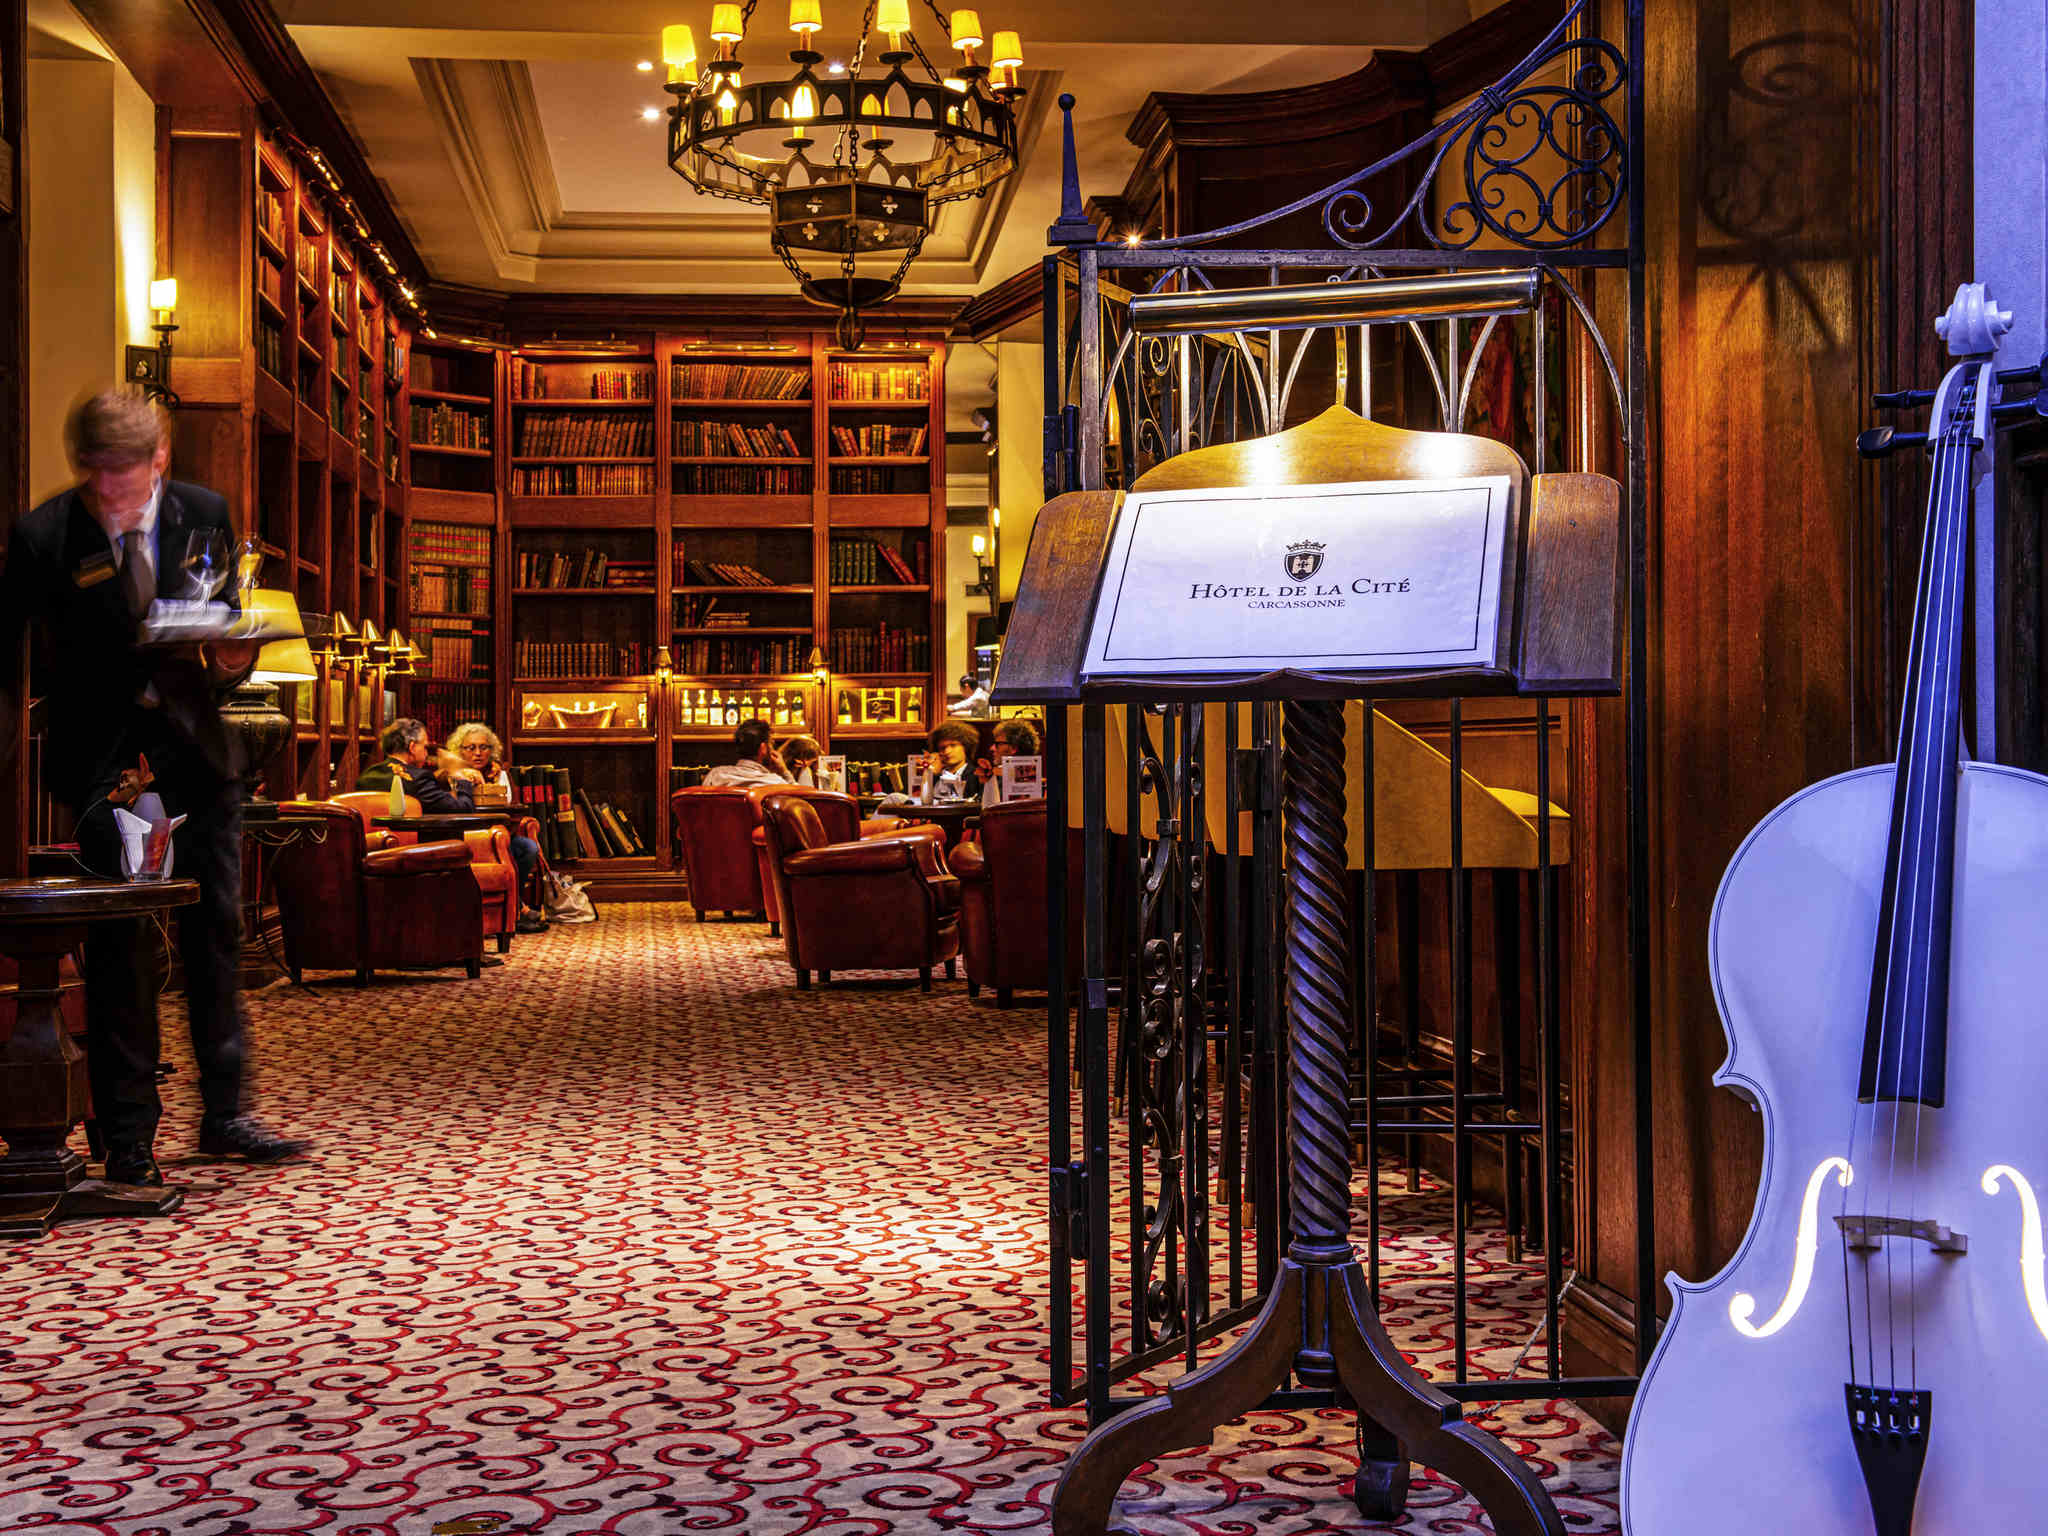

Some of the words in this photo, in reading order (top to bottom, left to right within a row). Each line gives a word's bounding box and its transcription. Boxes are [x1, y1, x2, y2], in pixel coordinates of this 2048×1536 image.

[1278, 586, 1307, 597] DE
[1316, 585, 1344, 596] LA
[1247, 599, 1346, 609] CARCASSONNE
